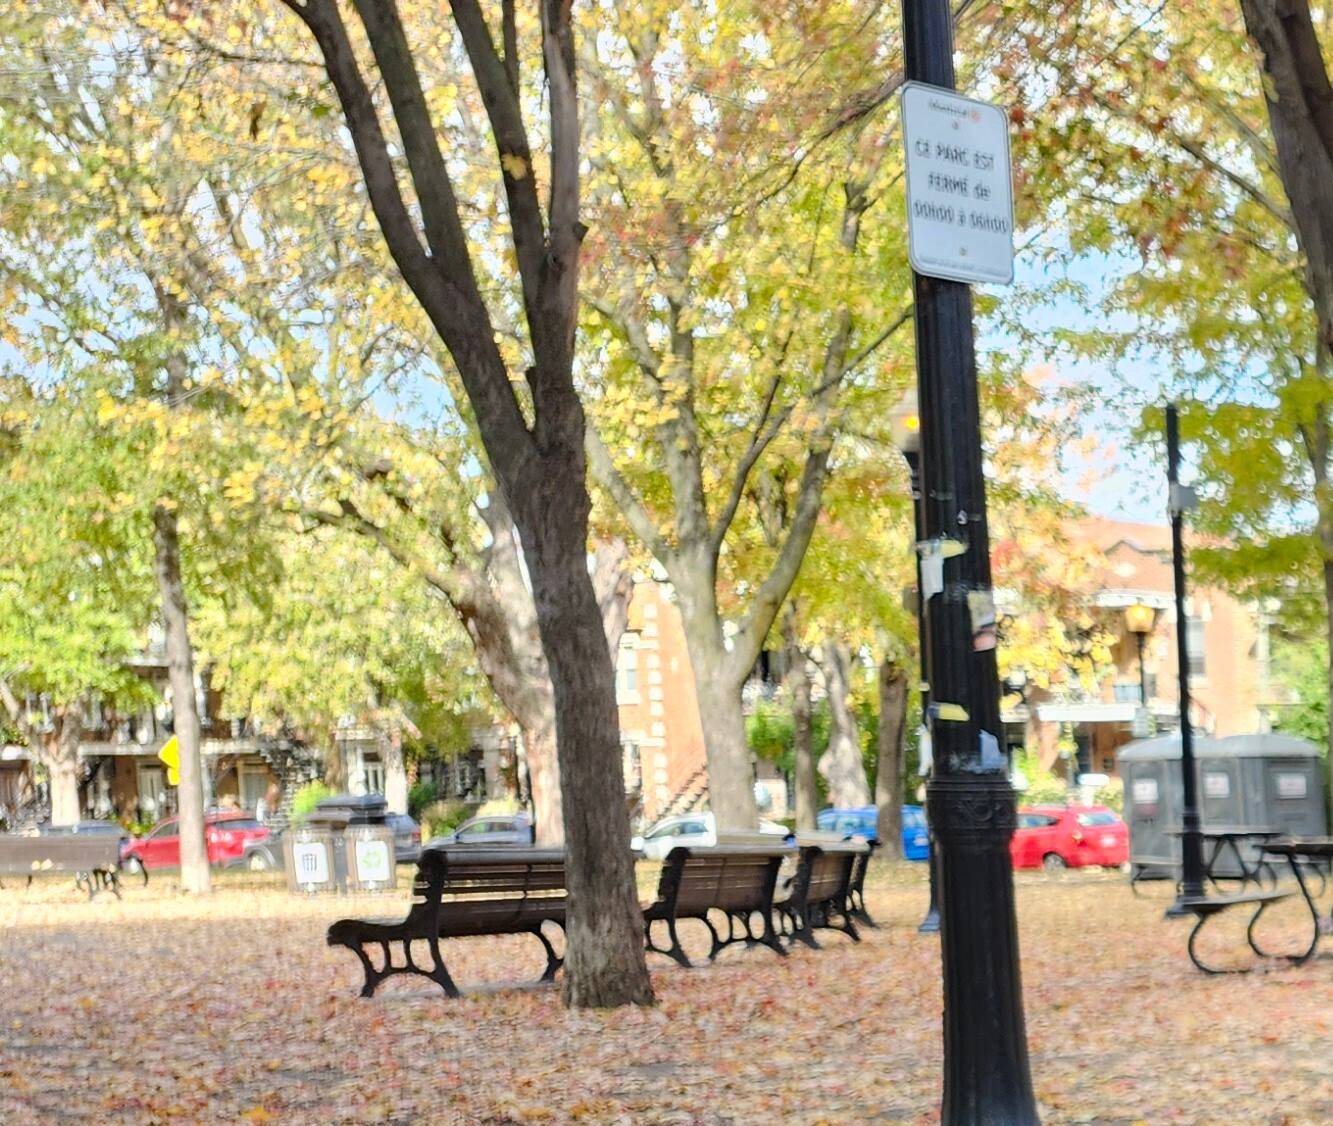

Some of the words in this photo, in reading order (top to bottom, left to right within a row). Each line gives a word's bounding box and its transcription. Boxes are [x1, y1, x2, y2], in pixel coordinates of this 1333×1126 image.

[915, 140, 930, 158] CE
[937, 143, 969, 168] PARC
[974, 152, 994, 170] EST
